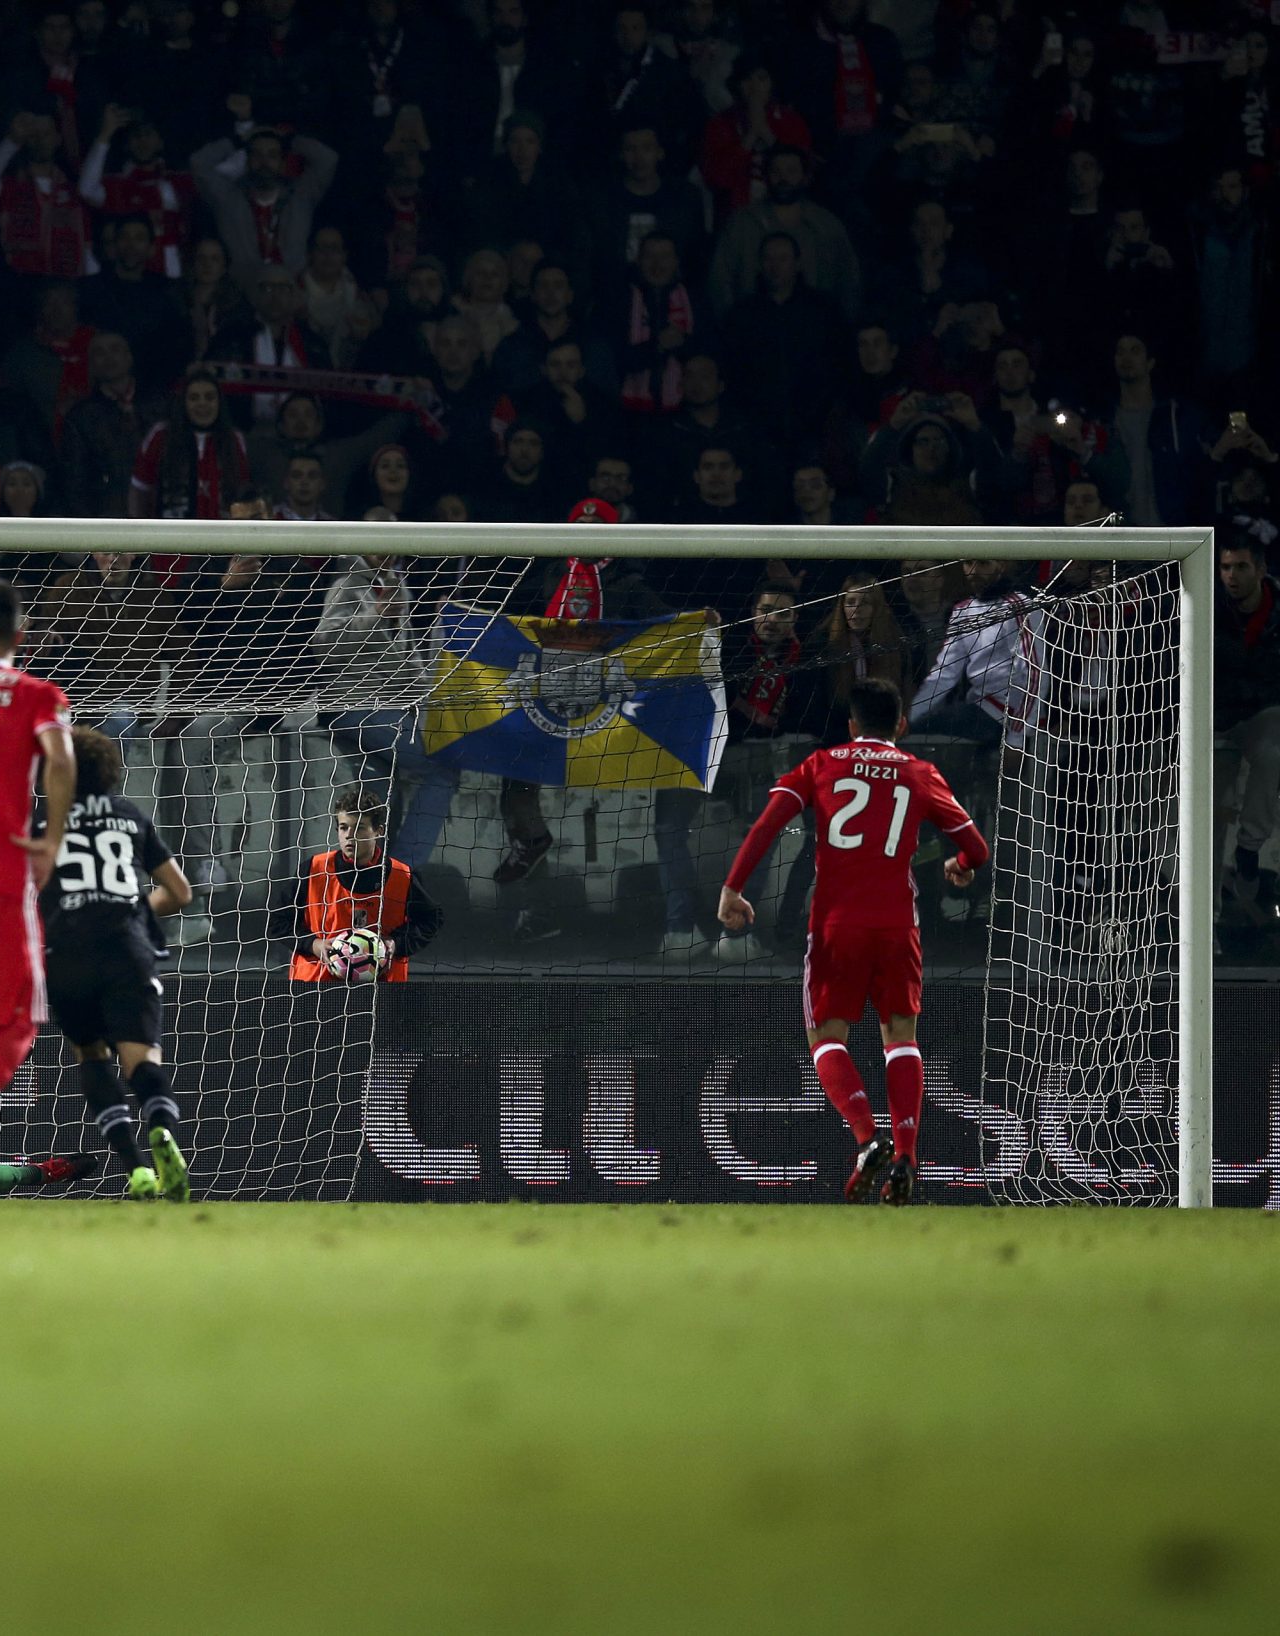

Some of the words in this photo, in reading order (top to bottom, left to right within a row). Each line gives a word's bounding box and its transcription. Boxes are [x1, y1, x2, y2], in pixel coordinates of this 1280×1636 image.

[853, 762, 898, 780] PIZZI
[827, 777, 912, 858] 21
[55, 829, 140, 898] 58
